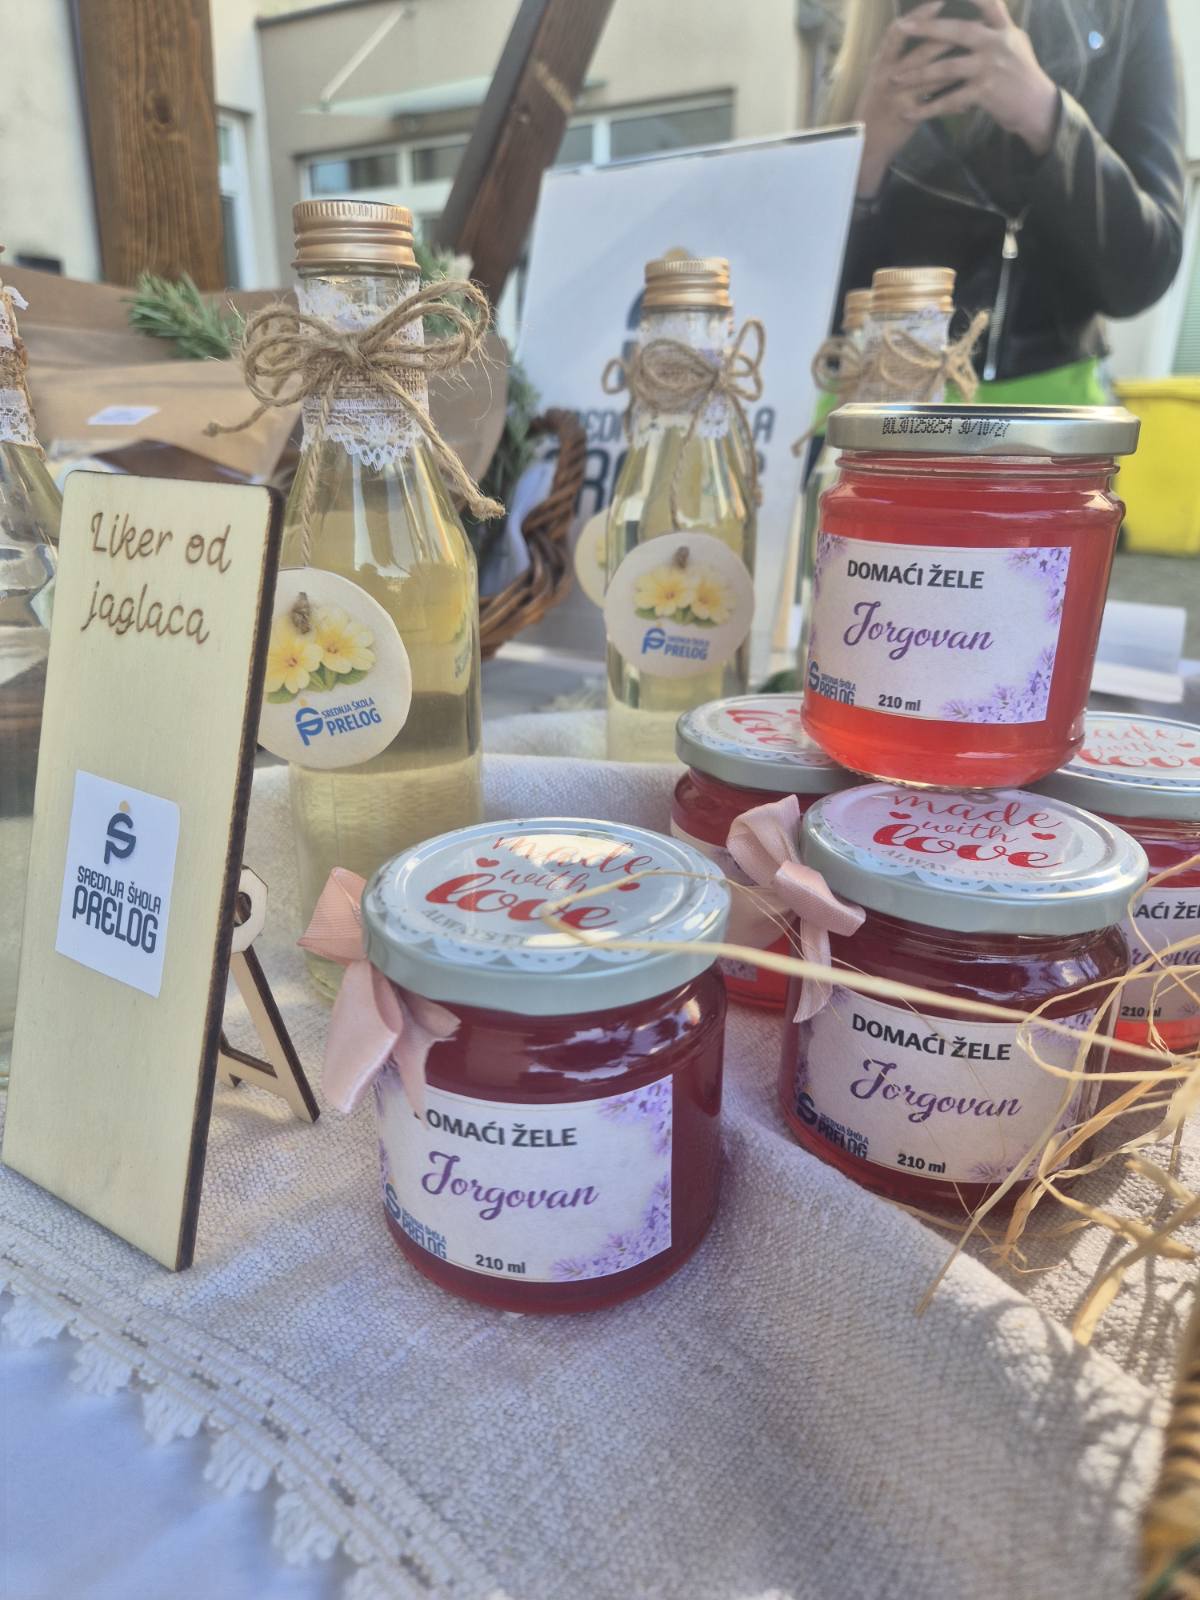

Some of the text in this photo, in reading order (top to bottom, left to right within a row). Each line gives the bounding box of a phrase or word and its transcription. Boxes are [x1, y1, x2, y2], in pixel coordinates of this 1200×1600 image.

[90, 512, 232, 574] Liker od
[847, 559, 985, 590] DOMAĆI ŽELE
[80, 580, 210, 645] jaglaca
[843, 601, 994, 661] Jorgovan
[326, 707, 382, 736] PRELOG
[878, 694, 921, 711] 210 ml
[894, 795, 1063, 829] made
[922, 820, 1018, 844] with
[873, 823, 1063, 869] love
[77, 865, 162, 915] SREDNJA ŠKOLA
[425, 873, 618, 930] love
[500, 869, 592, 894] with
[72, 885, 159, 954] PRELOG
[1121, 1006, 1145, 1017] 210
[852, 1013, 1012, 1061] DOMAĆI ŽELE
[850, 1058, 1022, 1123] Jorgovan
[414, 1108, 578, 1148] OMAĆI ŽELE
[897, 1153, 946, 1173] 210 ml
[421, 1151, 599, 1221] Jorgovan
[475, 1253, 526, 1274] 210 ml
